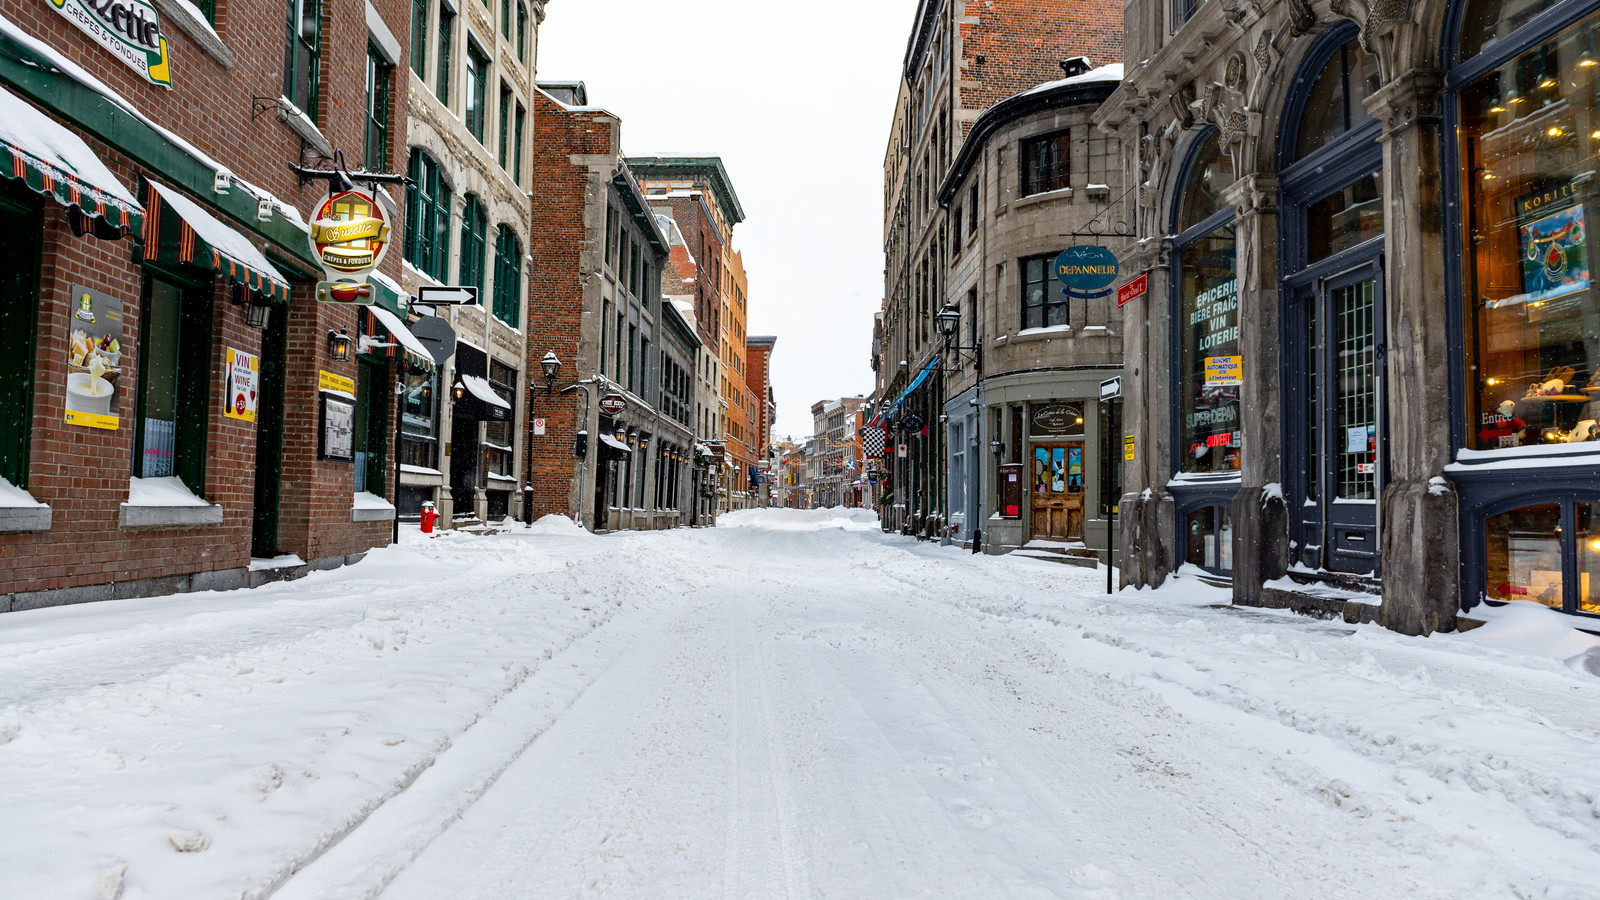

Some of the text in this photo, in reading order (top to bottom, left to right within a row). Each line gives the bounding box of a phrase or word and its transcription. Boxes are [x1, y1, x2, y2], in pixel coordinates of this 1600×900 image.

[66, 3, 147, 71] CRÊPES & FONDUES
[1524, 184, 1577, 211] KORITE
[321, 211, 342, 221] Chez
[326, 224, 372, 242] Suzette
[323, 254, 342, 264] CRÊPES
[348, 257, 371, 265] FONDUES
[1059, 265, 1116, 275] DEPANNEUR
[1212, 295, 1238, 317] FRAÎC
[1210, 314, 1227, 332] VIN
[235, 353, 250, 369] VIN
[1206, 363, 1238, 371] AUTOMATIQUE
[234, 374, 250, 387] WINE
[1189, 442, 1205, 454] ATM
[1206, 432, 1232, 448] OUVERT
